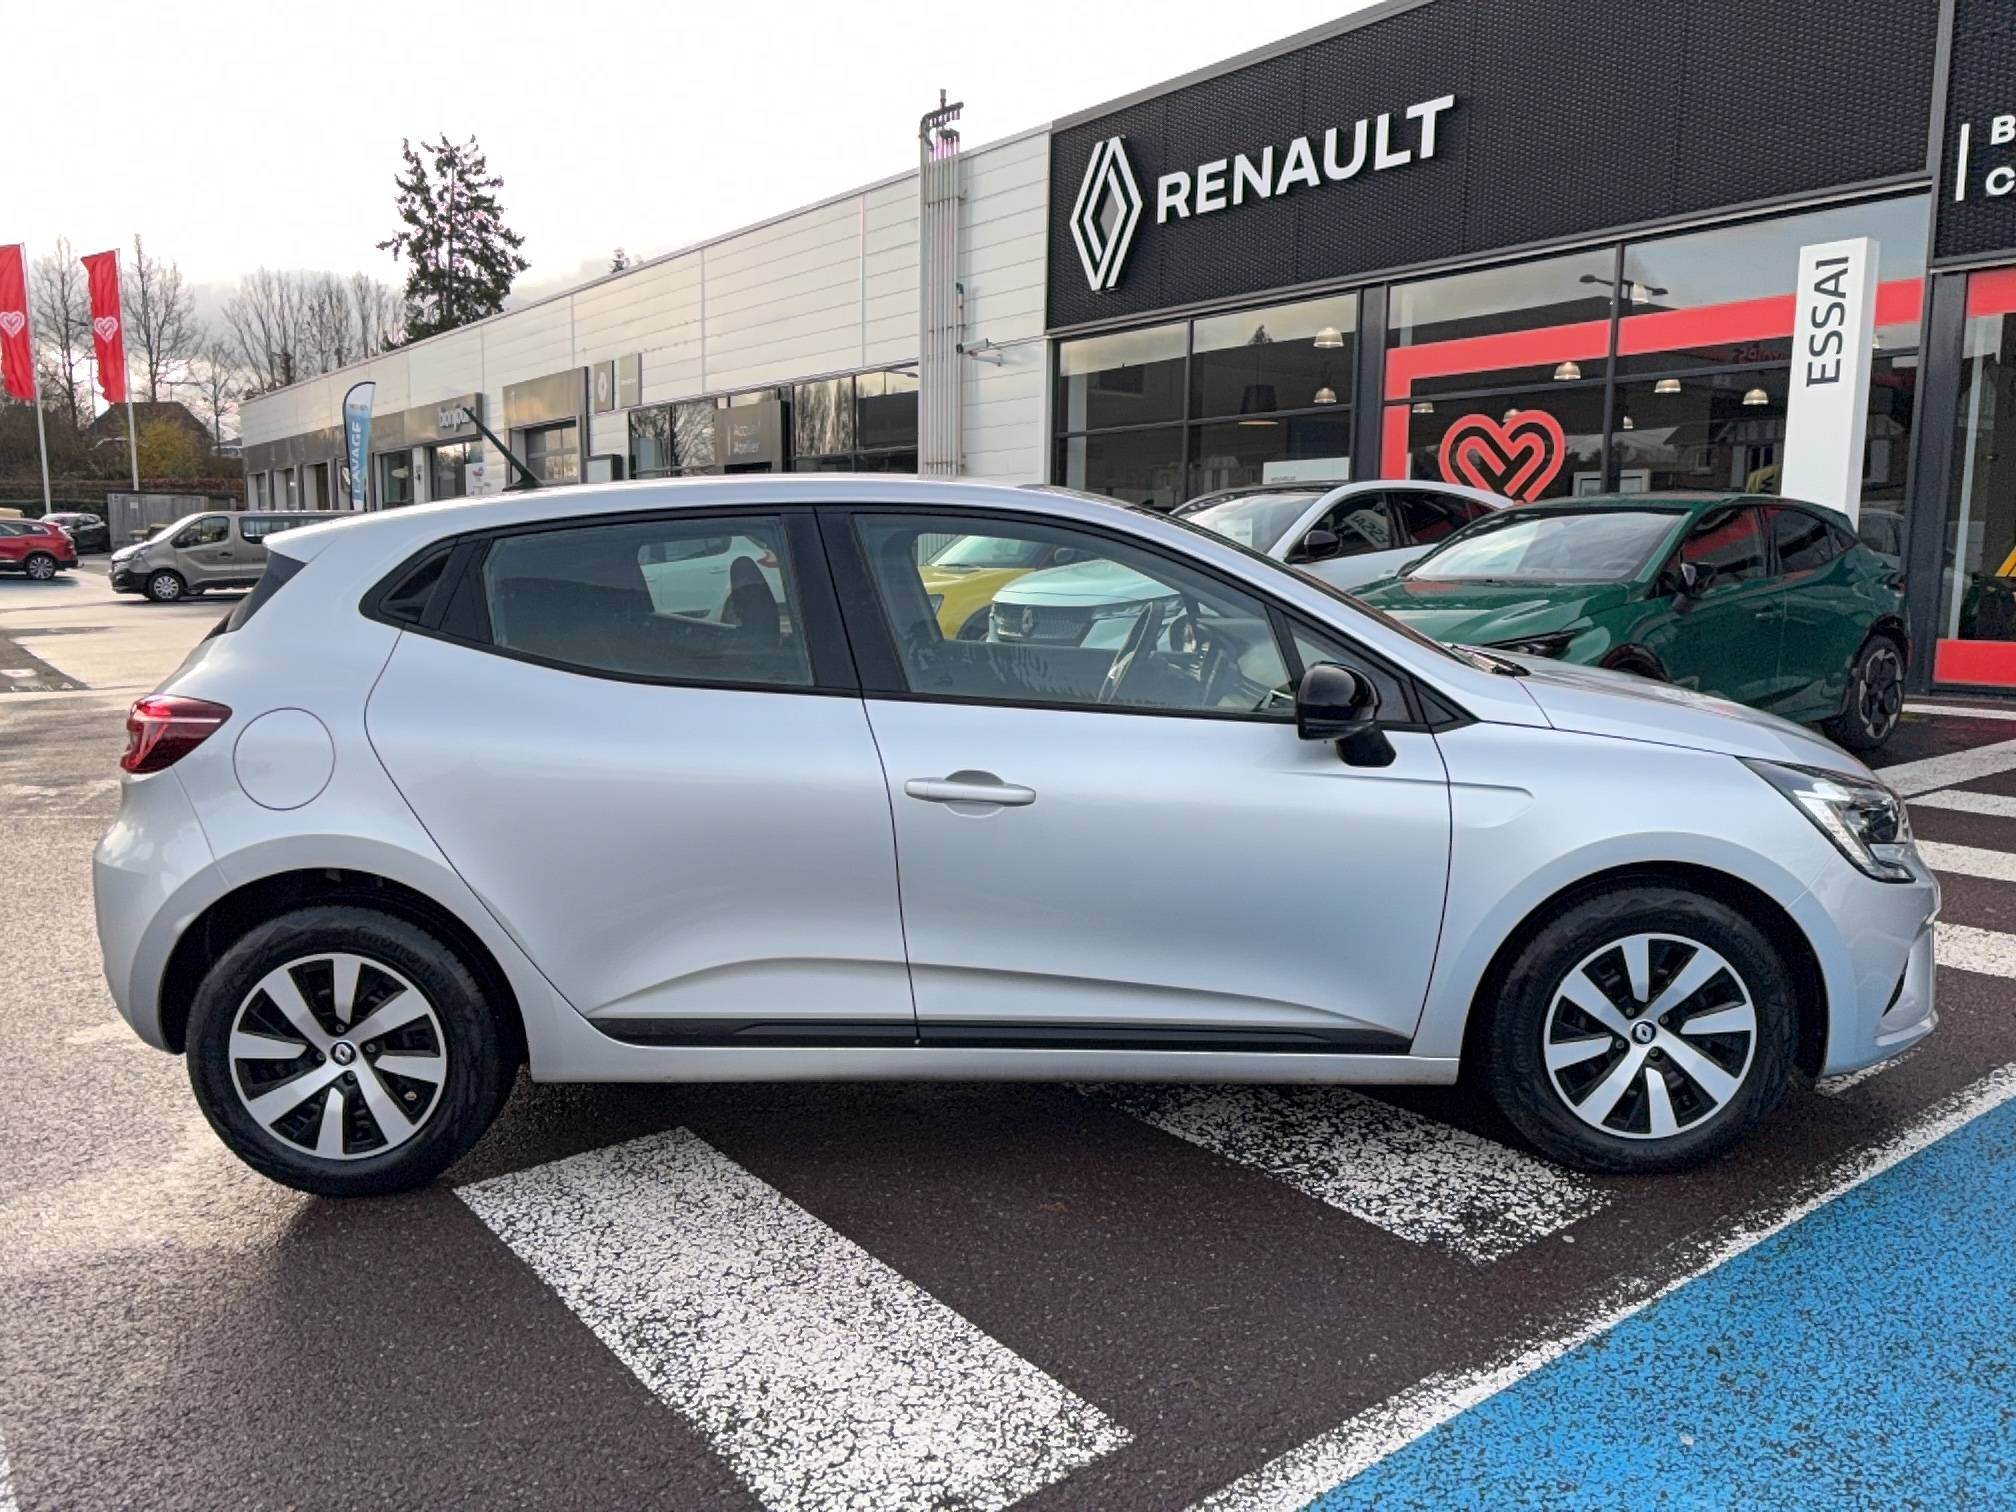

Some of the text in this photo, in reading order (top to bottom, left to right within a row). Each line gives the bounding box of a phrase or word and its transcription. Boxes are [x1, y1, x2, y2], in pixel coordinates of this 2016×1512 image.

[1156, 94, 1455, 224] RENAULT
[1990, 114, 2016, 145] B
[1806, 256, 1849, 388] ESSAI
[351, 420, 362, 493] LAVAGE
